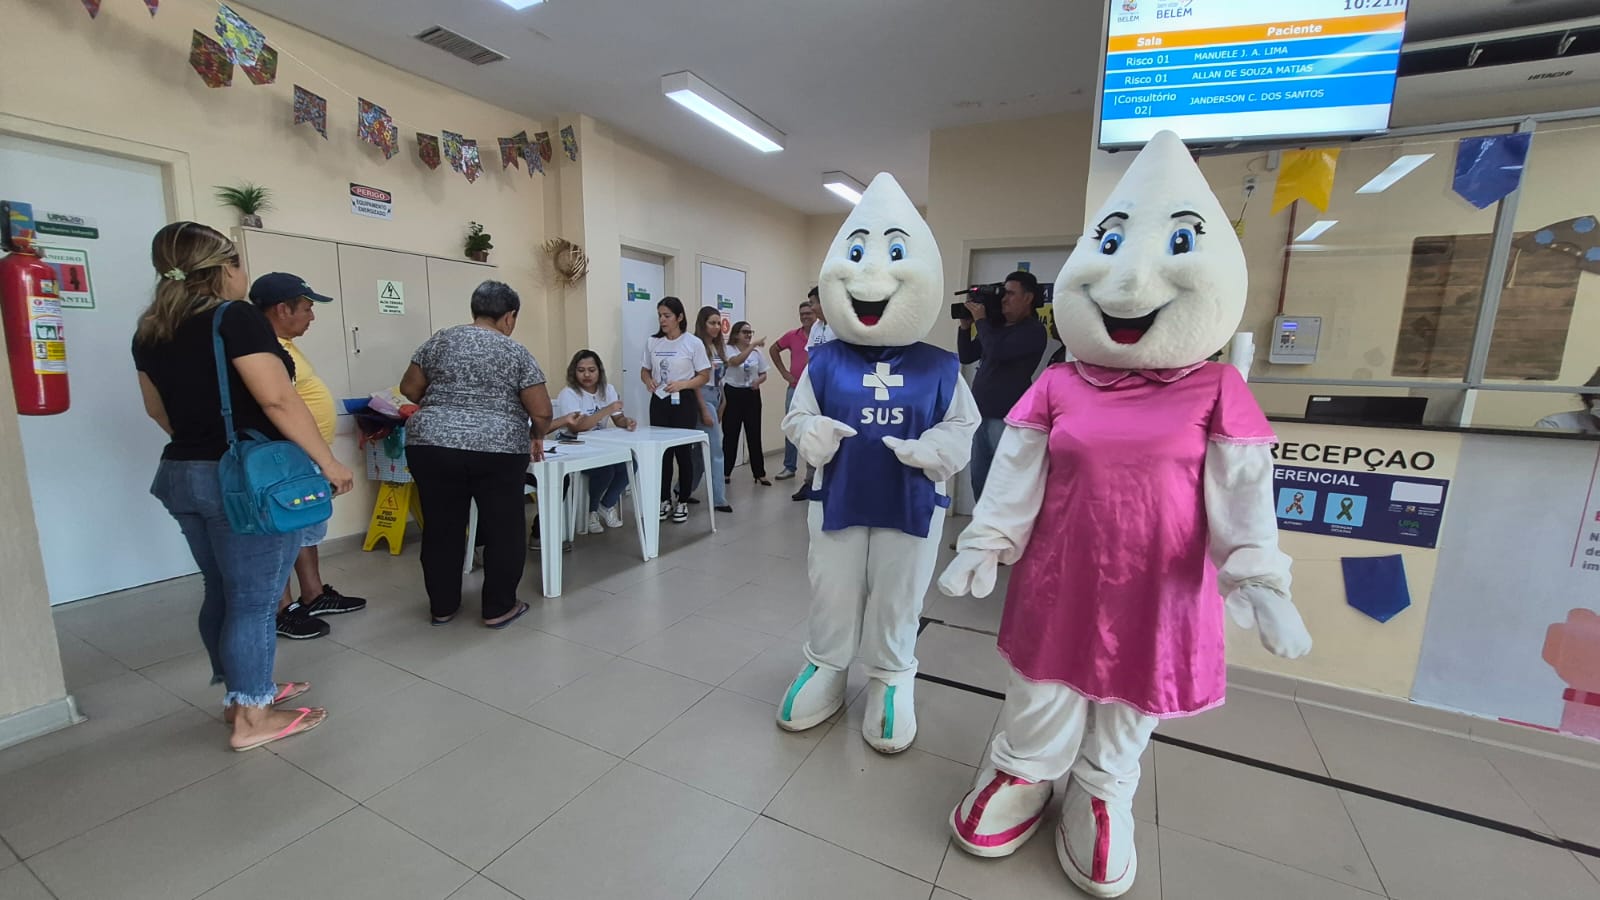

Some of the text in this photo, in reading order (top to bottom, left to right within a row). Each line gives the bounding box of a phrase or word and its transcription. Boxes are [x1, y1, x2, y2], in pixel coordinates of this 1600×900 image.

[1267, 24, 1322, 36] Paciente
[1137, 36, 1162, 47] Sala
[1194, 46, 1288, 61] MANUELE J. A. LIMA
[1126, 55, 1169, 66] Risco 01
[1192, 64, 1313, 80] ALLAN DE SOUZA MATIAS
[1528, 70, 1574, 80] HITACHI
[1124, 74, 1168, 85] Risco 01
[1190, 89, 1325, 105] JANDERSON C. DOS SANTOS
[357, 188, 385, 199] PERIGO
[860, 407, 904, 425] SUS
[1273, 468, 1360, 487] ERENCIAL
